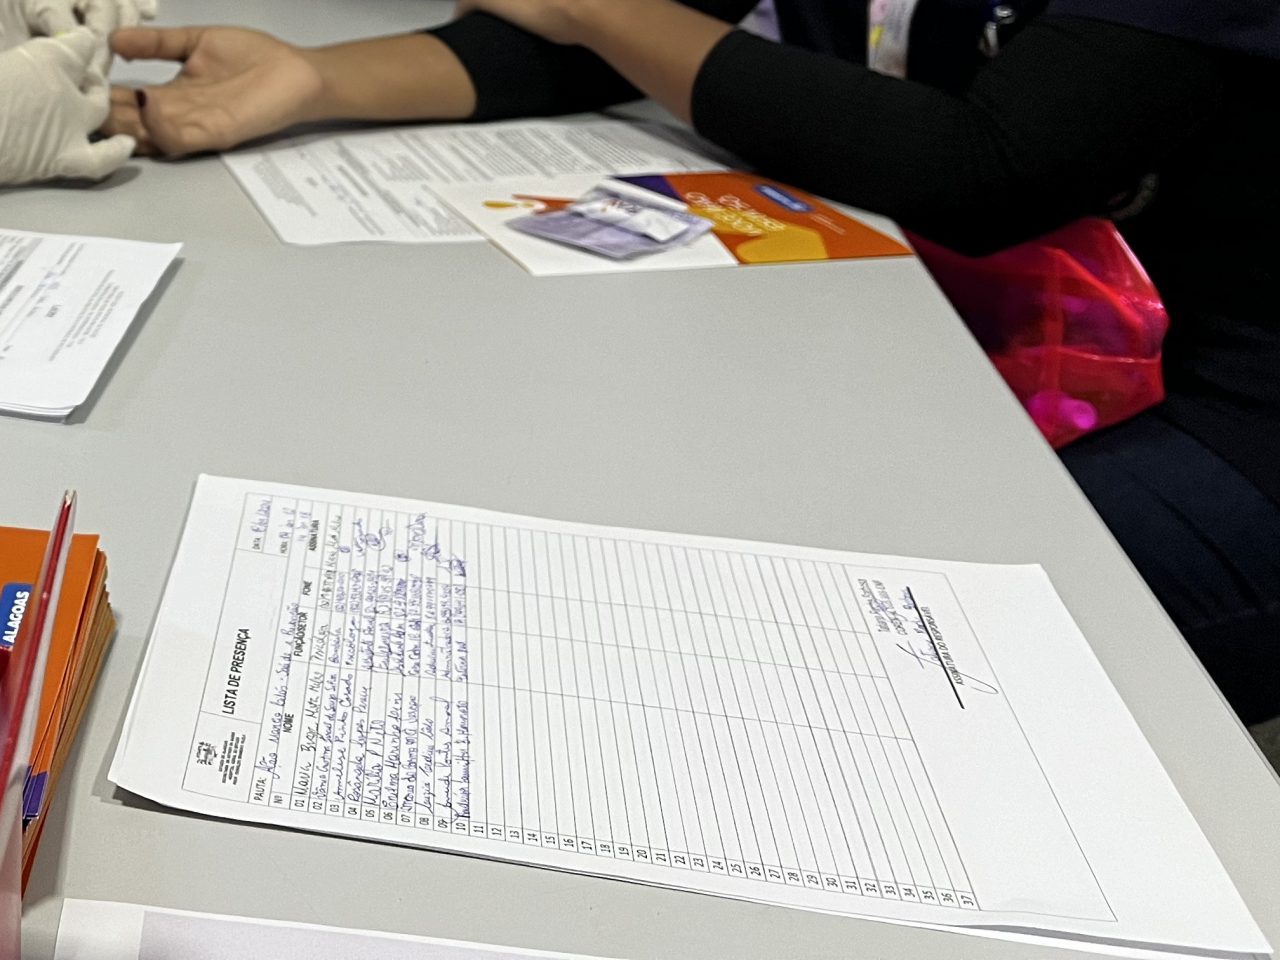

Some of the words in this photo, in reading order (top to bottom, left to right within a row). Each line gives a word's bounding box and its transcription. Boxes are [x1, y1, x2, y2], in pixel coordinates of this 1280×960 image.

[301, 580, 312, 595] FONE
[1, 590, 31, 645] ALAGOAS
[230, 627, 252, 674] PRESENÇA
[227, 673, 240, 686] DE
[222, 689, 238, 715] LISTA
[282, 713, 294, 732] NOME
[253, 777, 266, 800] PAUTA:
[294, 798, 304, 807] 01
[312, 801, 322, 810] 02
[330, 803, 339, 812] 03
[348, 806, 356, 815] 04
[365, 808, 374, 817] 05
[383, 811, 392, 820] 06
[401, 813, 410, 822] 07
[420, 816, 428, 825] 08
[457, 822, 465, 830] 10
[475, 825, 484, 834] 11
[492, 828, 502, 836] 12
[510, 830, 519, 839] 13
[528, 832, 538, 841] 14
[546, 835, 556, 844] 15
[564, 838, 574, 847] 16
[582, 841, 592, 850] 17
[601, 843, 611, 853] 18
[619, 847, 630, 856] 19
[637, 849, 648, 859] 20
[656, 852, 667, 862] 21
[675, 855, 686, 865] 22
[694, 858, 704, 867] 23
[713, 861, 724, 870] 24
[731, 863, 742, 873] 25
[751, 866, 761, 876] 26
[769, 869, 780, 879] 27
[789, 872, 800, 882] 28
[807, 874, 819, 885] 29
[825, 877, 838, 888] 30
[845, 880, 857, 890] 31
[865, 883, 877, 893] 32
[884, 886, 897, 896] 33
[904, 887, 915, 898] 34
[923, 890, 935, 900] 35
[942, 893, 954, 902] 36
[962, 896, 974, 906] 37
